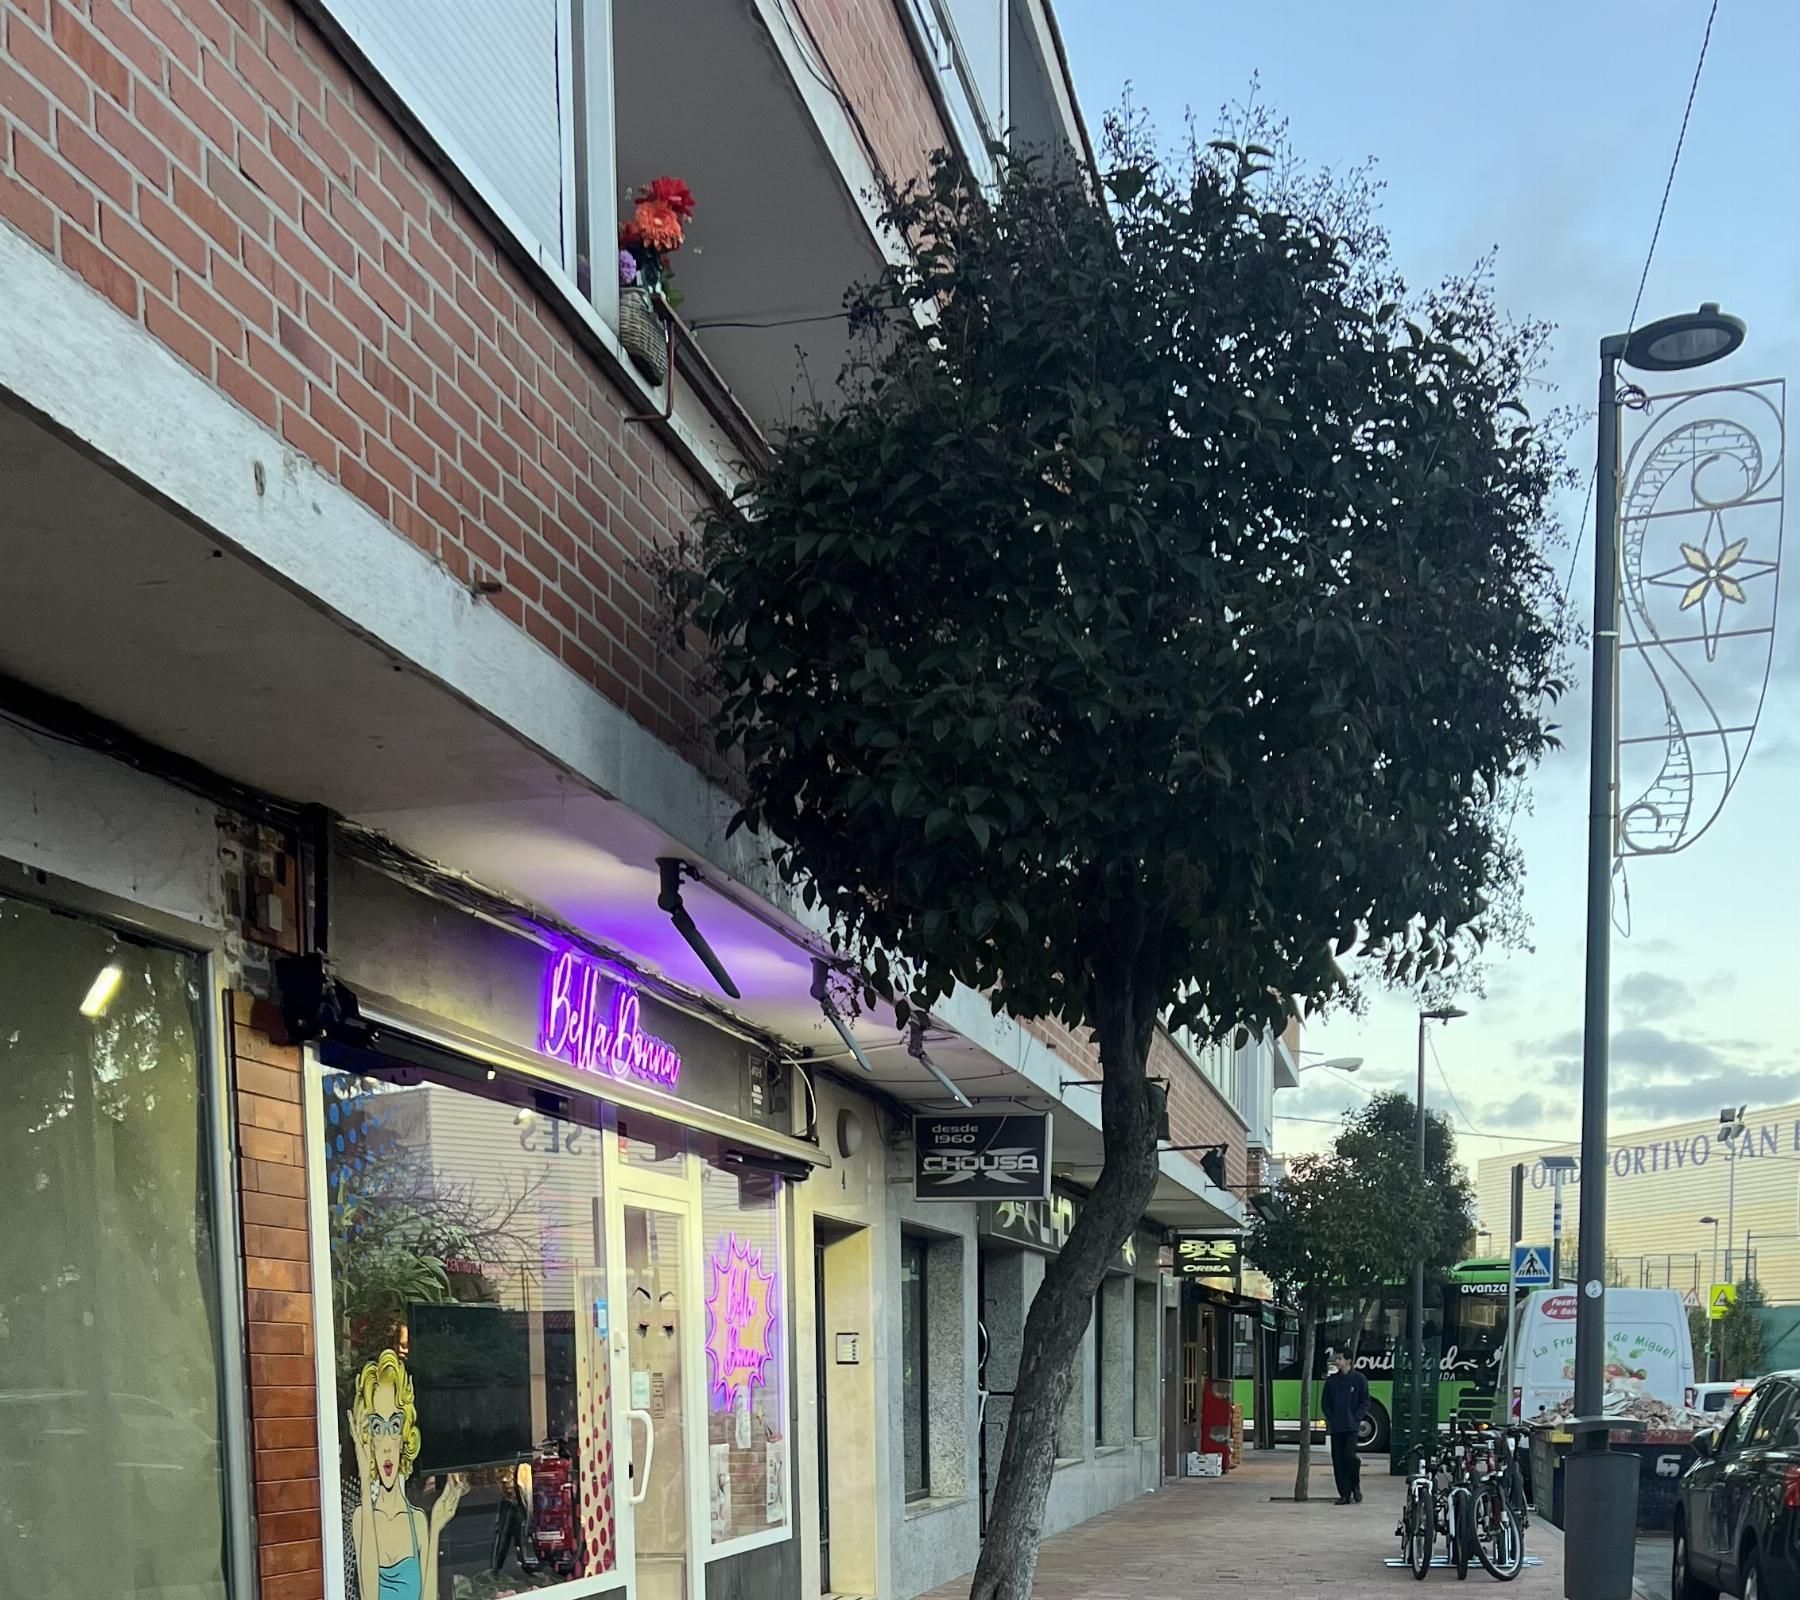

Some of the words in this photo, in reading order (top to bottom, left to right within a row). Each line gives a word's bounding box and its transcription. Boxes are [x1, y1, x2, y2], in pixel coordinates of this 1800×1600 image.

[546, 952, 614, 1071] Bella
[611, 991, 682, 1084] Donna
[932, 1124, 979, 1133] desde
[935, 1134, 976, 1144] 1960
[923, 1155, 1038, 1171] CHOUSA
[1461, 1284, 1507, 1294] avanza
[1533, 1346, 1548, 1358] La
[1553, 1336, 1576, 1350] Fru
[1613, 1332, 1628, 1342] de
[1634, 1336, 1676, 1359] Miguel
[1656, 1454, 1682, 1477] 6
